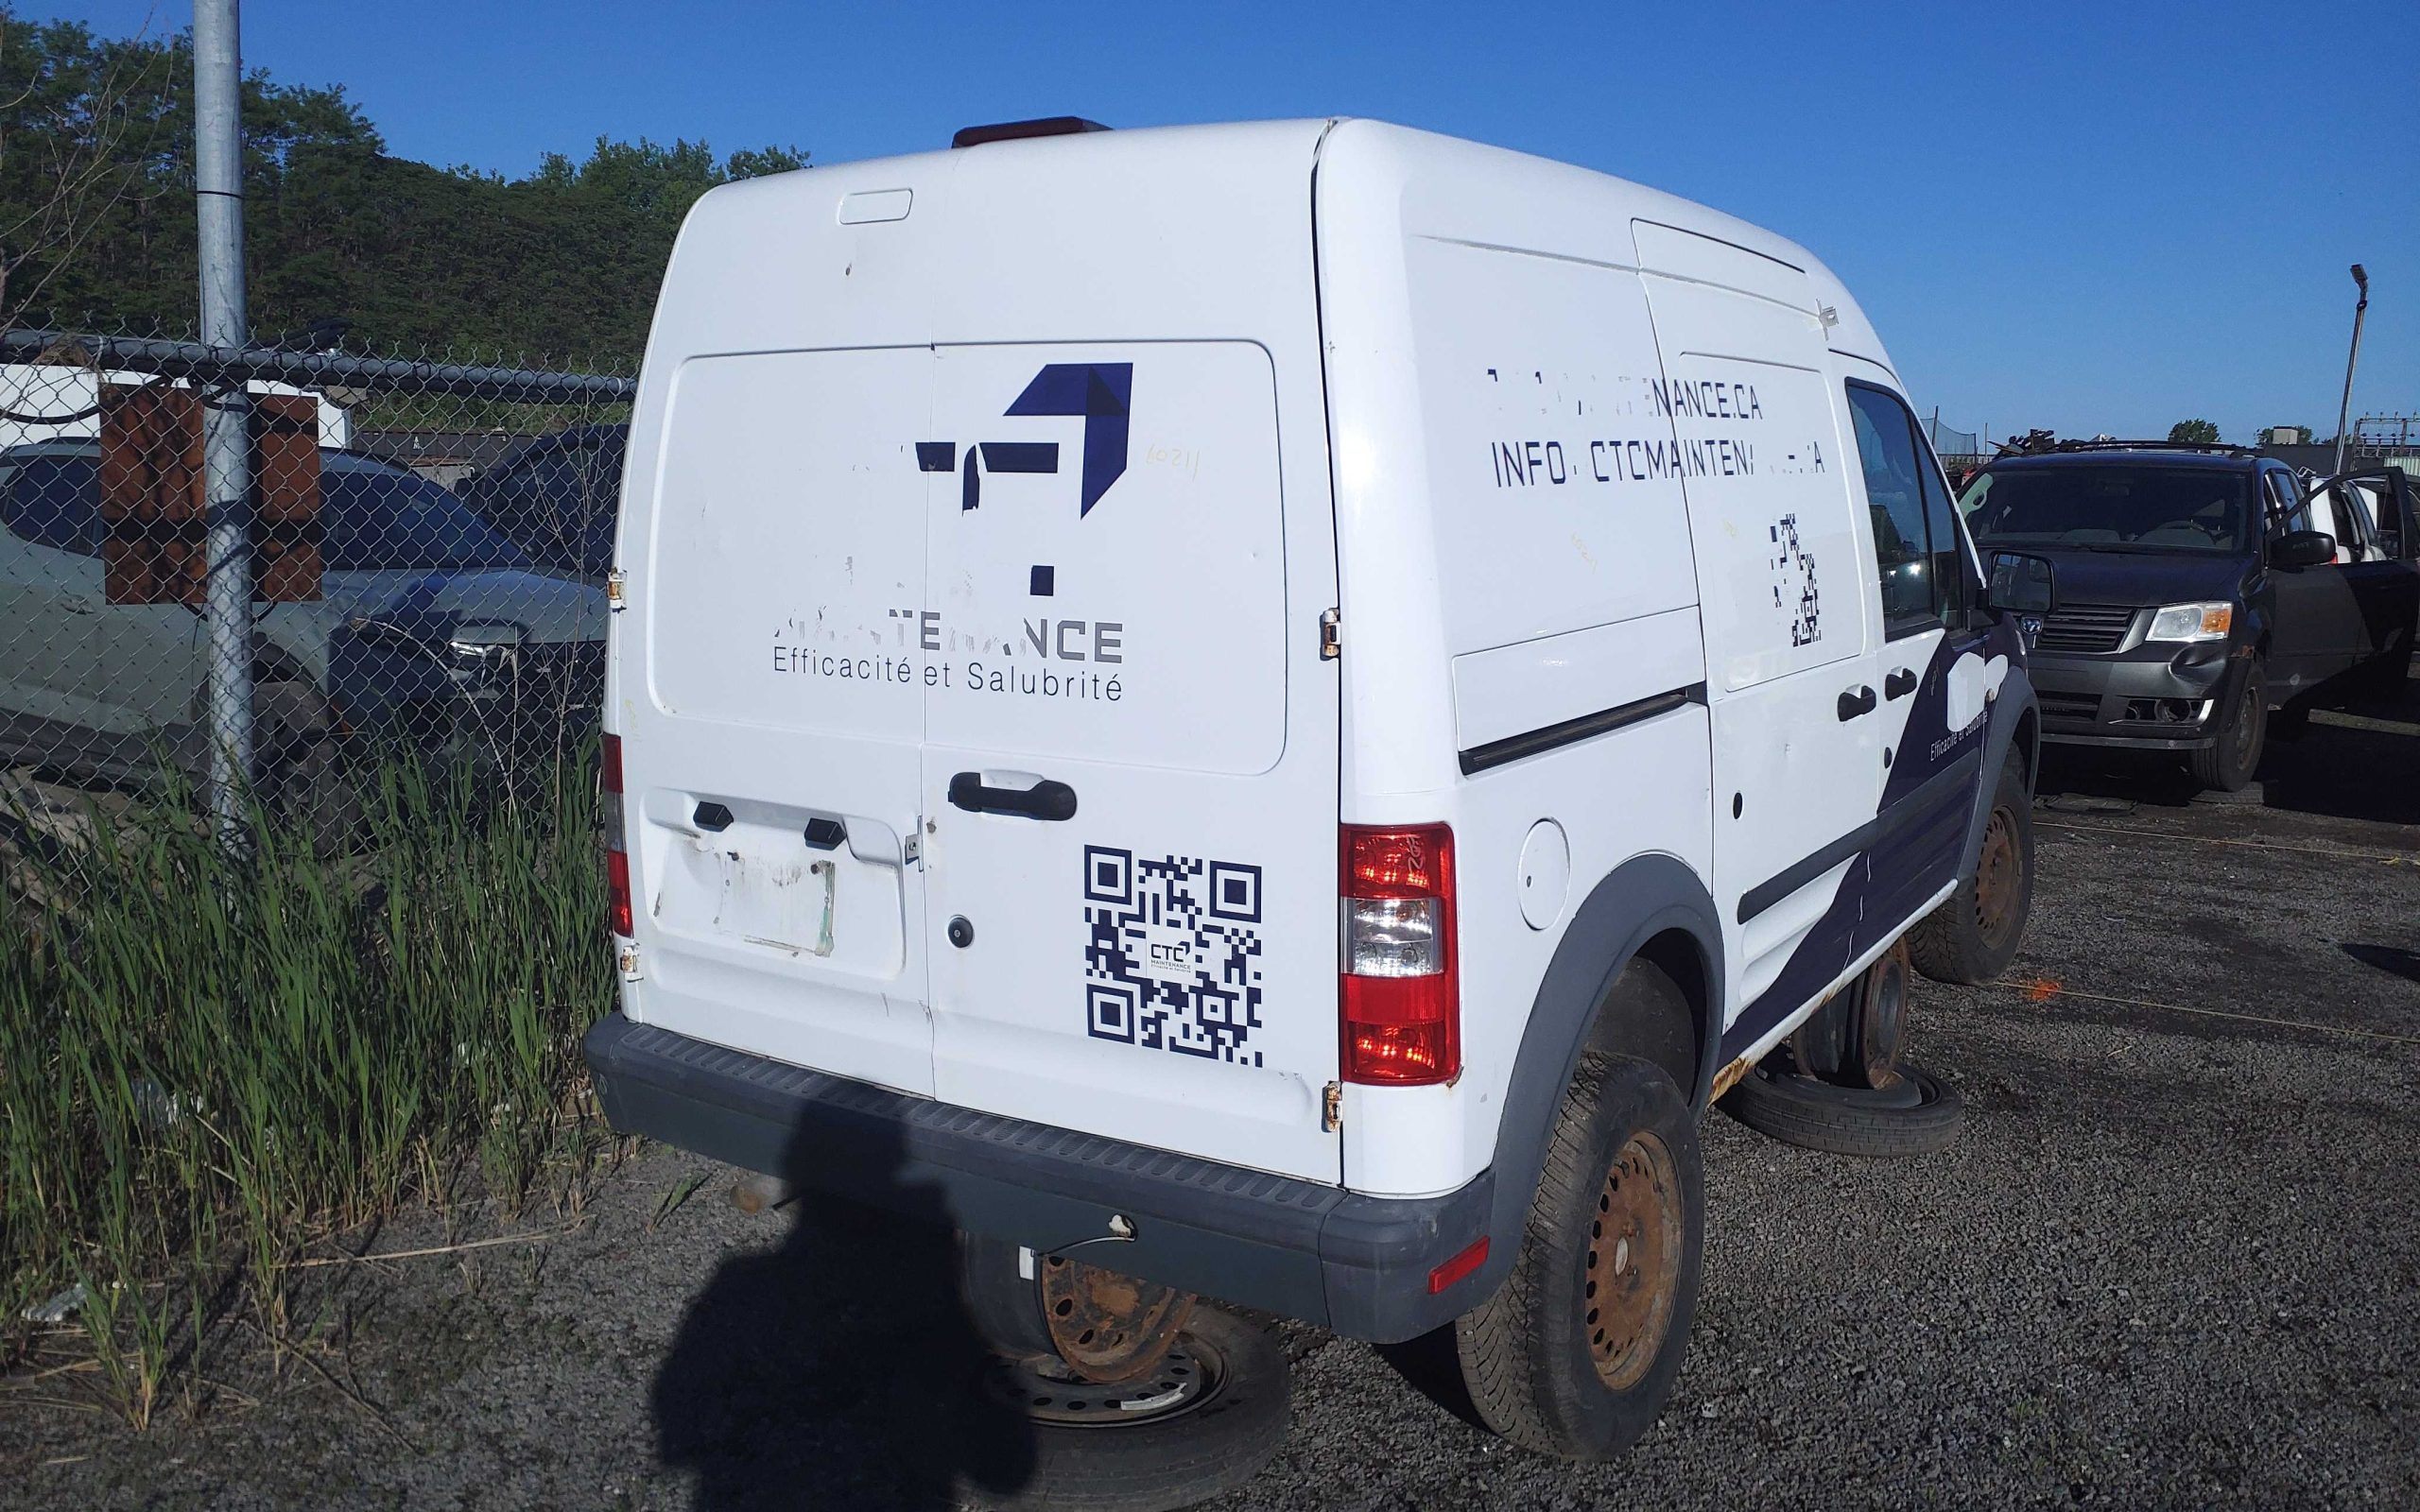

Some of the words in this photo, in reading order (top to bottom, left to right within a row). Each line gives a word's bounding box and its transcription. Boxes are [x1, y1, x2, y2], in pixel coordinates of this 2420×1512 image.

[773, 645, 911, 683] Efficacité
[924, 662, 950, 688] et
[967, 662, 1123, 701] Salubrité
[1150, 943, 1184, 963] CTC
